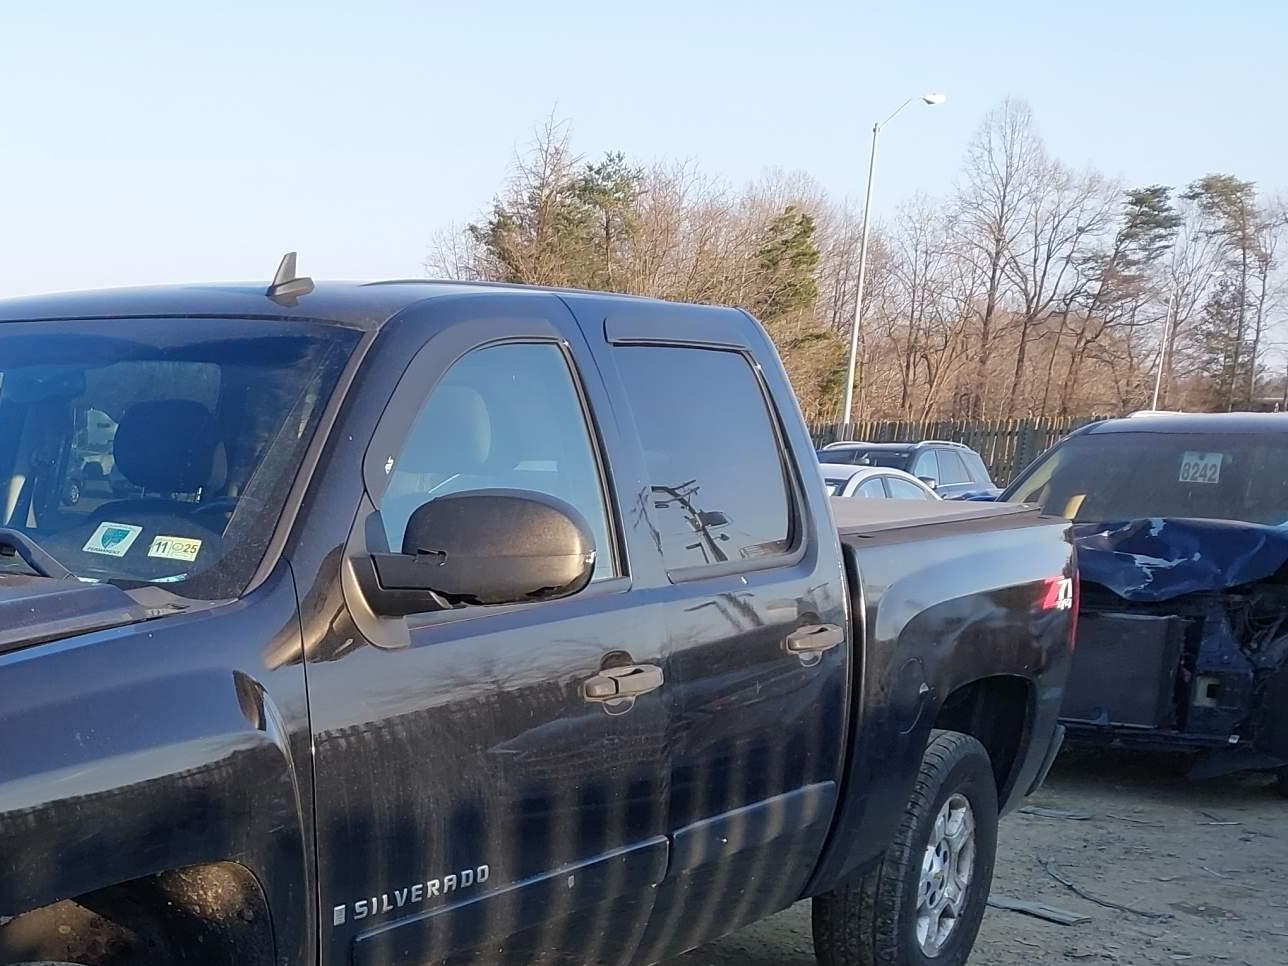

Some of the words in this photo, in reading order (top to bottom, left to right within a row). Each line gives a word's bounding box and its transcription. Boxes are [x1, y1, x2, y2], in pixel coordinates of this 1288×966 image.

[1181, 462, 1218, 482] 8242
[155, 541, 168, 553] 11
[183, 543, 199, 554] 25
[353, 864, 490, 920] SILVERADO
